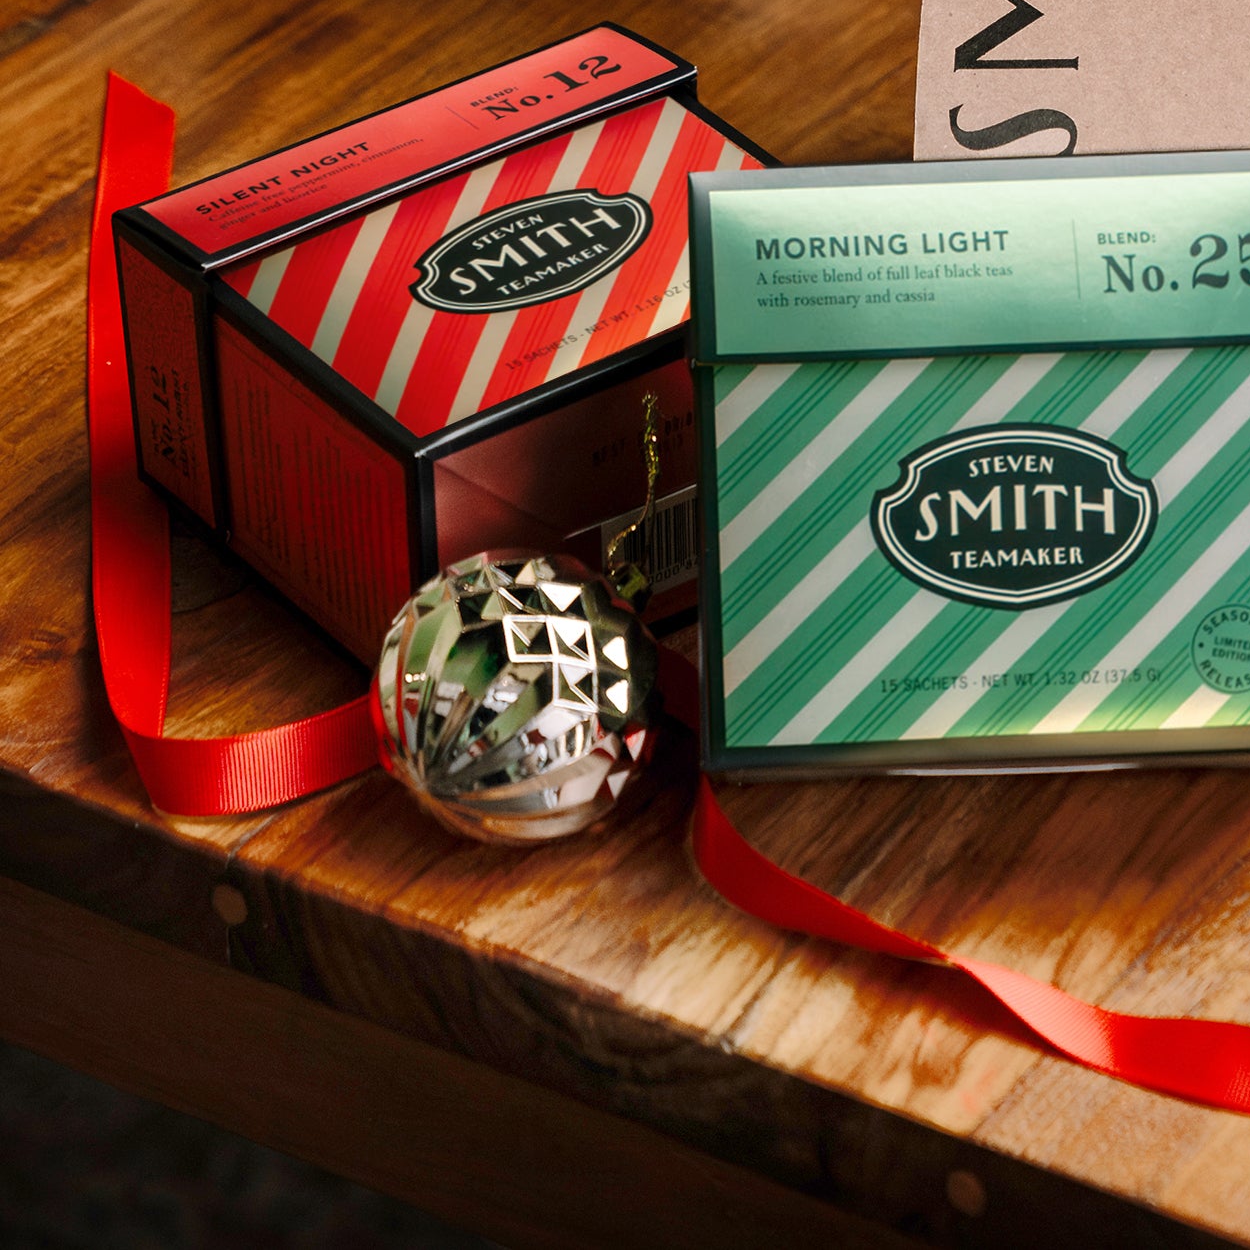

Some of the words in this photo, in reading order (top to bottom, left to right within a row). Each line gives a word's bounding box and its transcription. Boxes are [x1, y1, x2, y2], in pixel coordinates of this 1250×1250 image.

[470, 86, 519, 108] BLEND:
[482, 94, 554, 121] No.
[543, 55, 622, 93] 12
[196, 176, 282, 215] SILENT
[290, 141, 370, 177] NIGHT
[208, 198, 262, 223] Caffeine
[262, 188, 287, 203] free
[219, 211, 257, 231] ginger
[260, 202, 282, 214] and
[282, 183, 328, 204] licorice
[472, 213, 544, 250] STEVEN
[755, 233, 908, 261] MORNING
[922, 230, 1009, 254] LIGHT
[1097, 231, 1157, 245] BLEND:
[449, 207, 622, 295] SMITH
[497, 243, 609, 295] TEAMAKER
[756, 272, 769, 285] A
[772, 268, 818, 285] festive
[822, 266, 863, 283] blend
[867, 266, 884, 281] of
[886, 265, 910, 280] full
[914, 264, 941, 279] leaf
[943, 263, 982, 278] black
[985, 265, 1014, 277] teas
[1101, 254, 1179, 293] No.
[757, 293, 789, 308] with
[794, 295, 861, 309] rosemary
[864, 289, 891, 304] and
[895, 289, 935, 303] cassia
[505, 358, 522, 371] 15
[523, 335, 578, 362] SACHETS
[585, 319, 609, 335] NET
[664, 286, 682, 298] OZ
[969, 455, 1054, 478] STEVEN
[914, 484, 1116, 542] SMITH
[950, 546, 1084, 569] TEAMAKER
[880, 678, 899, 693] 15
[903, 675, 968, 692] SACHETS
[981, 674, 1008, 688] NET
[1044, 670, 1076, 685] 1.32
[1081, 669, 1100, 684] OZ
